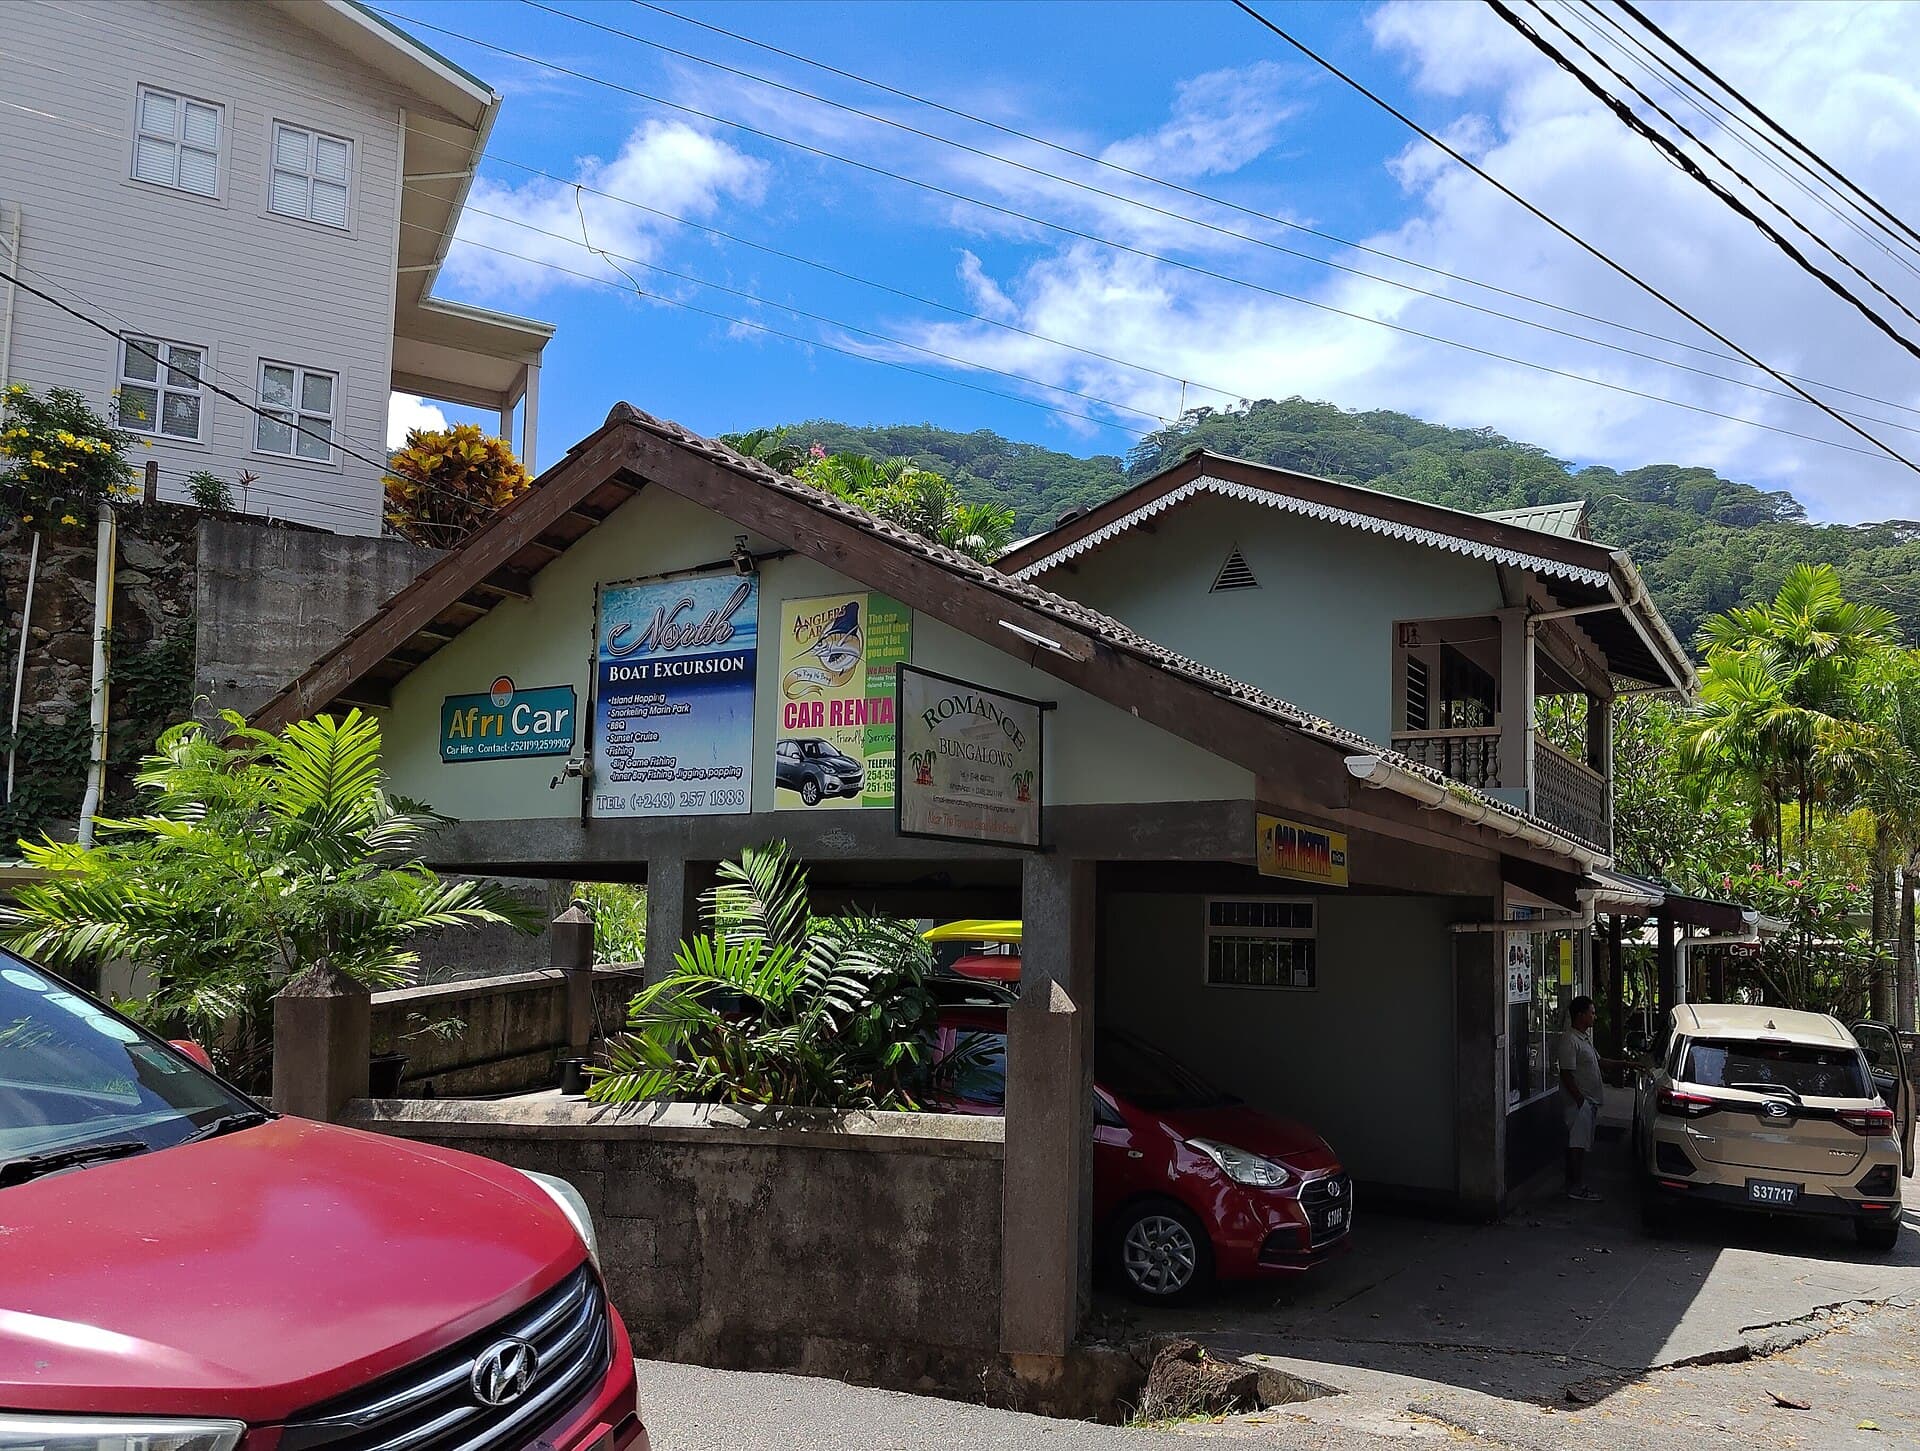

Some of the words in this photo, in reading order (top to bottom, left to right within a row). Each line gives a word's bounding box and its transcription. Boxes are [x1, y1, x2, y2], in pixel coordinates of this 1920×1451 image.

[608, 582, 751, 656] North
[868, 614, 883, 624] The
[884, 614, 897, 622] car
[868, 624, 892, 635] rental
[893, 622, 909, 632] that
[868, 635, 888, 646] won't
[889, 635, 900, 644] let
[867, 648, 882, 659] you
[882, 646, 904, 656] down
[609, 665, 649, 682] BOAT
[654, 656, 745, 678] EXCURSION
[611, 695, 633, 705] Island
[634, 693, 666, 705] Hopping
[611, 707, 648, 719] Snorkeling
[672, 704, 690, 714] Park
[784, 701, 824, 729] CAR
[448, 707, 504, 739] Afri
[512, 704, 569, 735] Car
[610, 721, 625, 730] BBQ
[921, 695, 1026, 752] ROMANCE
[610, 733, 633, 743] Sunset
[634, 731, 658, 741] Cruise
[836, 729, 865, 748] Friendly
[446, 746, 460, 755] Car
[460, 744, 474, 754] Hire
[609, 746, 634, 757] Fishing
[939, 738, 1013, 768] BUNGALOWS
[626, 758, 648, 768] Game
[650, 757, 676, 768] Fishing
[632, 772, 647, 782] Bay
[708, 766, 742, 779] popping
[631, 792, 675, 809] (+248)
[680, 791, 706, 807] 257
[710, 790, 745, 806] 1888
[1696, 945, 1725, 955] Afri
[1729, 944, 1757, 957] Car
[1753, 1185, 1794, 1202] S37717
